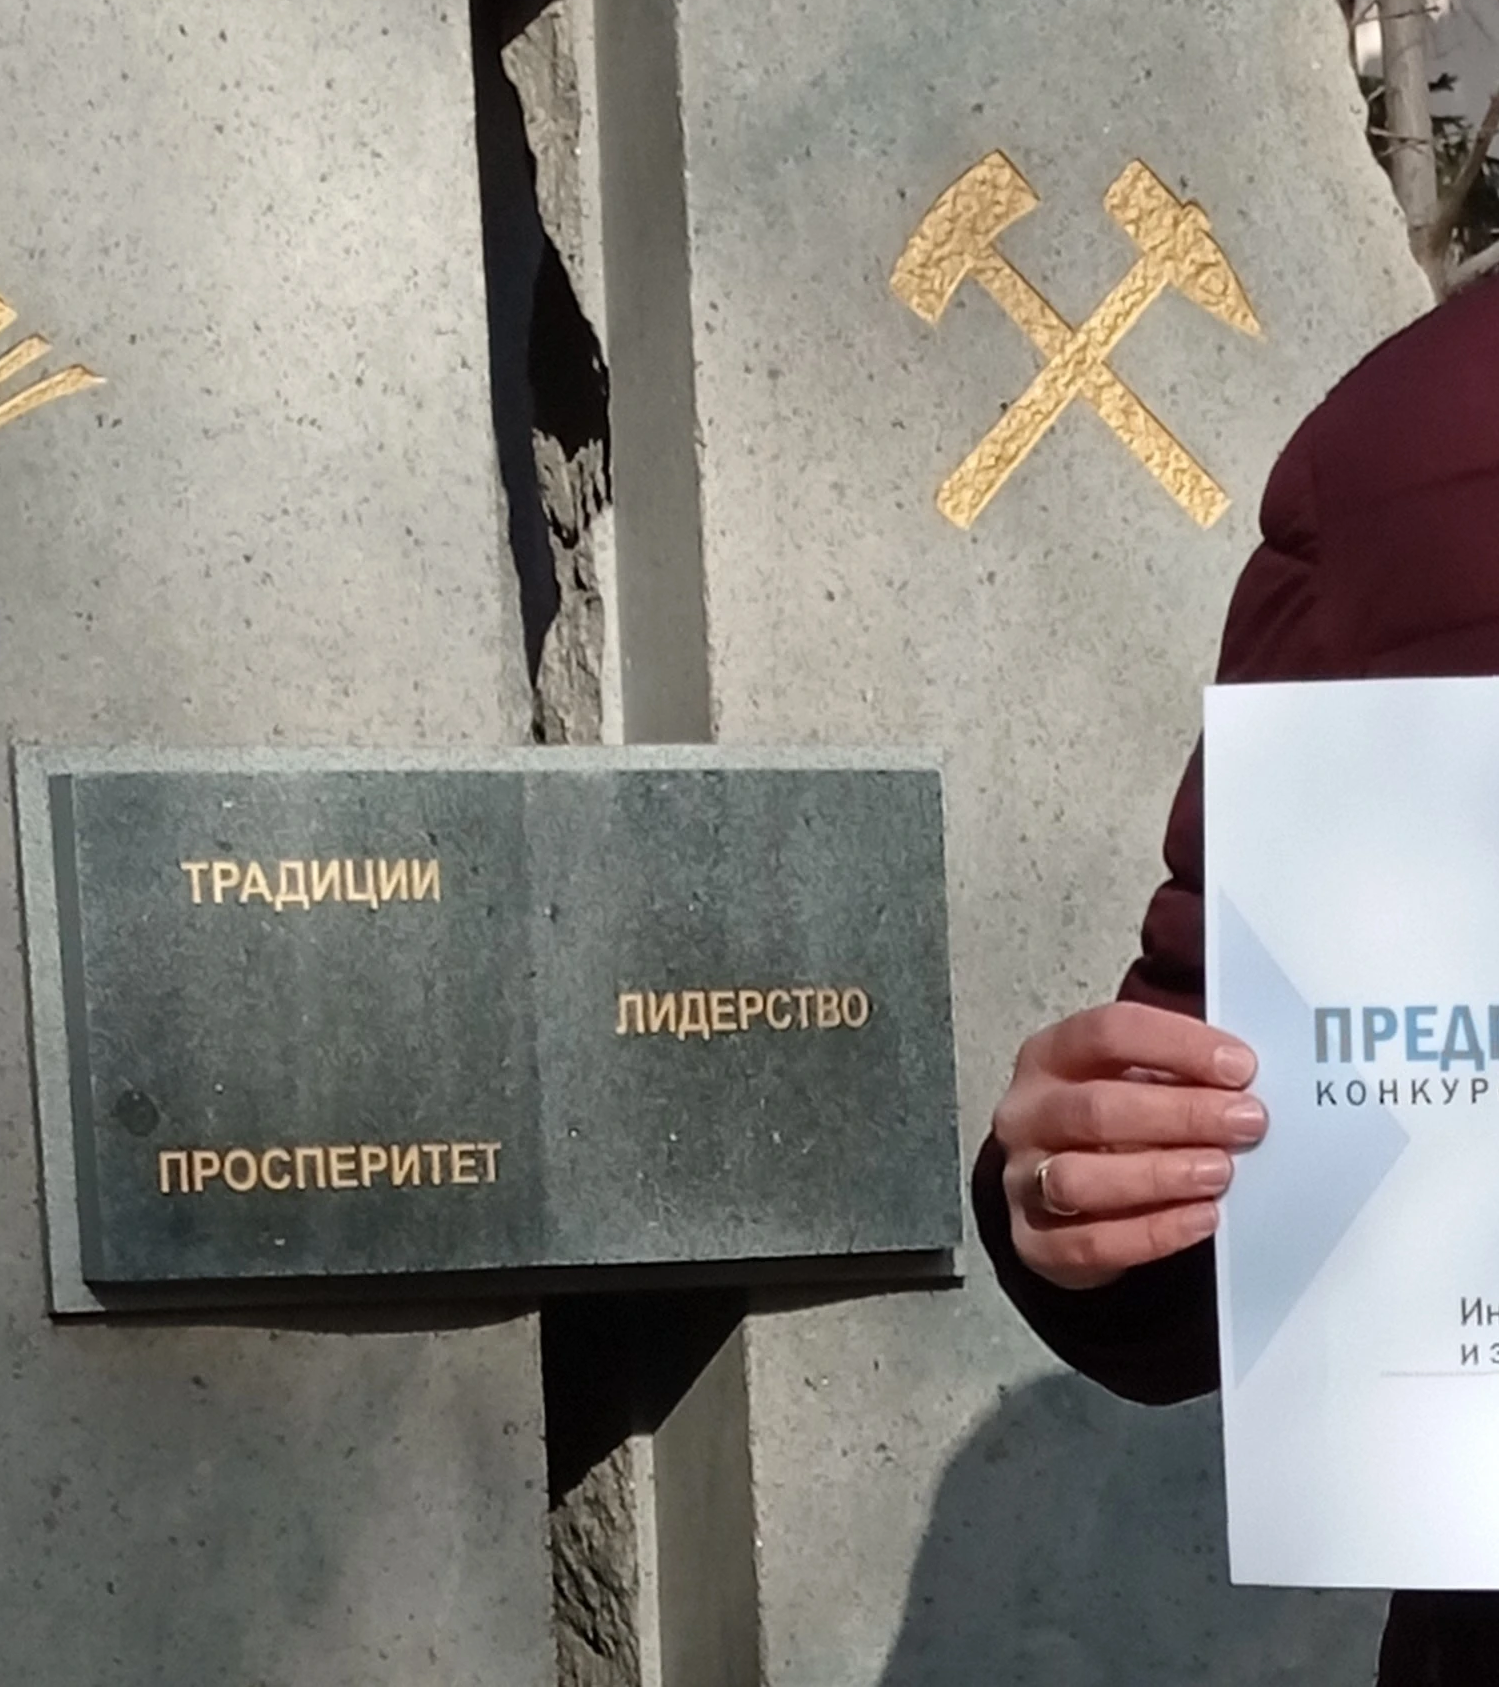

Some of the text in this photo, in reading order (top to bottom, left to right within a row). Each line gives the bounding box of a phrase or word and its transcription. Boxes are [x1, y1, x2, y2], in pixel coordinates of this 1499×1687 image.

[180, 859, 441, 910] ТРАДИЦИИ
[616, 985, 871, 1040] ЛИДЕРСТВО
[158, 1140, 502, 1194] ПРОСПЕРИТЕТ
[1460, 1343, 1479, 1366] и
